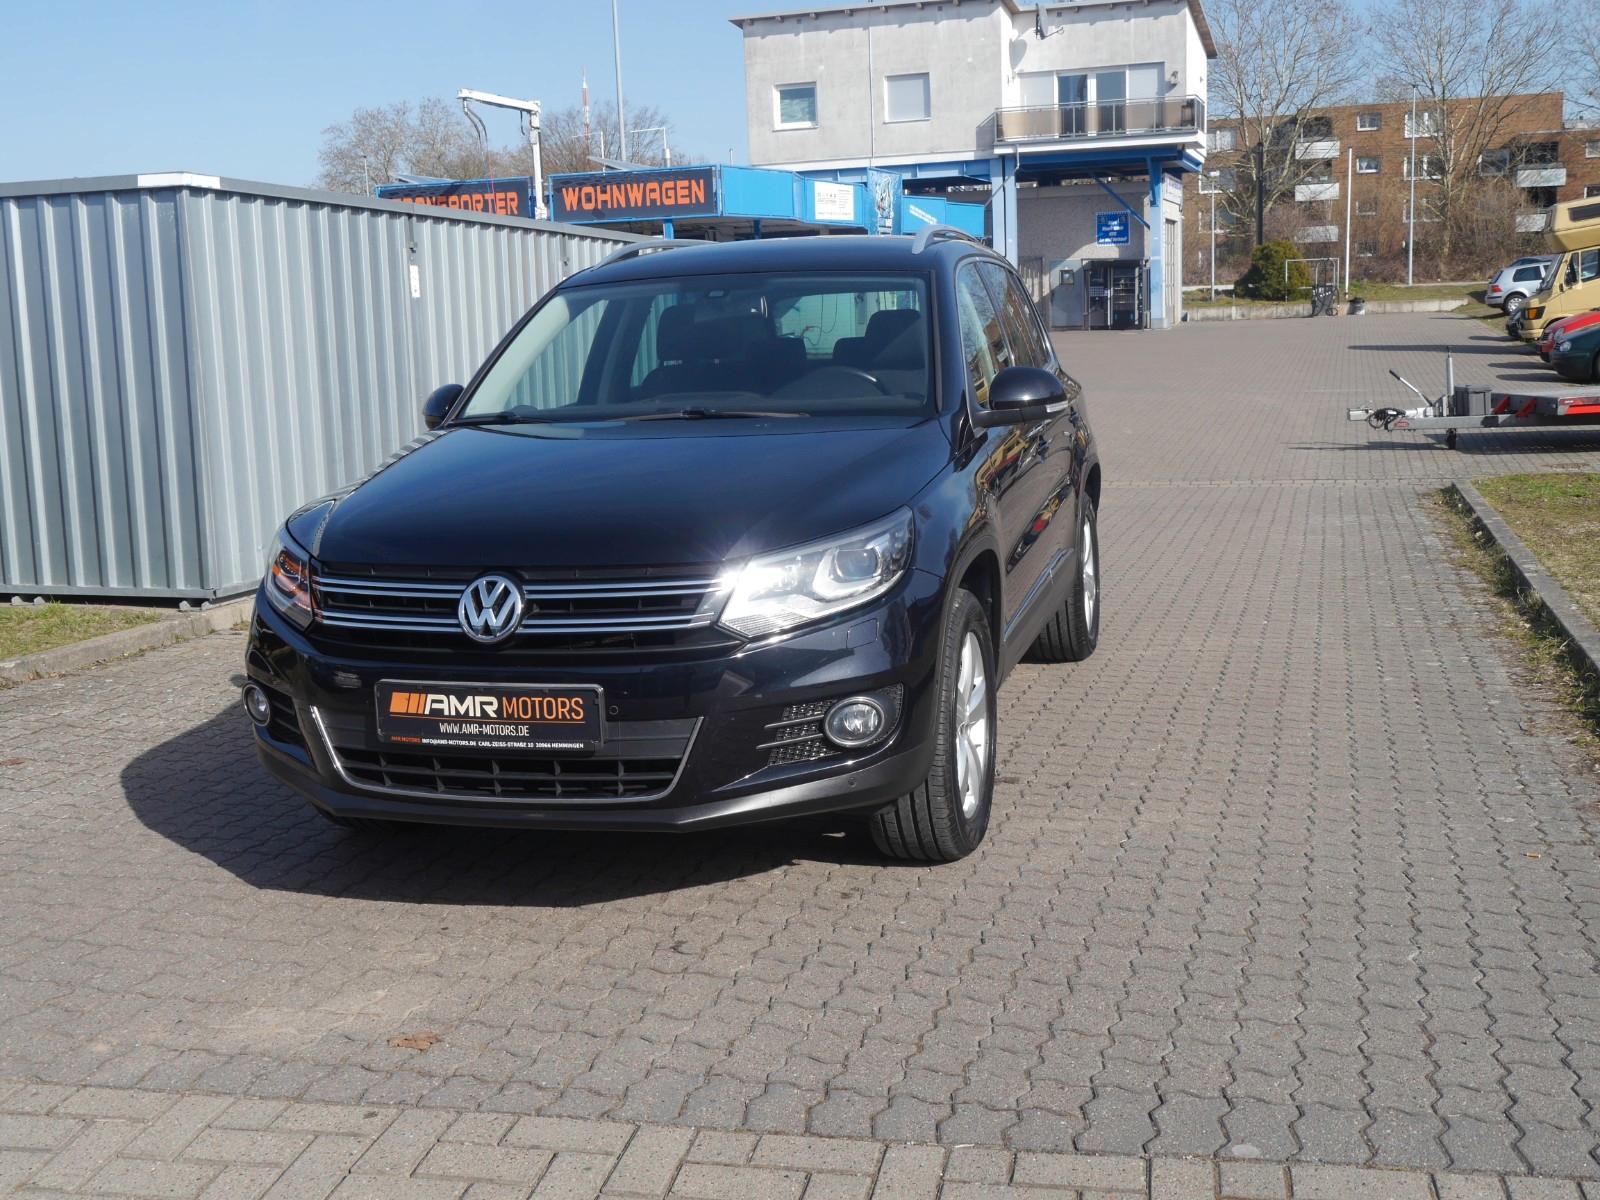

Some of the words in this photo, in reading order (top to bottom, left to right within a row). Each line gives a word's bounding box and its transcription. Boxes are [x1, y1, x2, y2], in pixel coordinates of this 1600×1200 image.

[562, 179, 705, 211] WOHNWAGEN
[424, 694, 499, 718] AMR
[502, 696, 585, 720] MOTORS
[439, 722, 530, 737] WWW.AMR-MOTORS.DE
